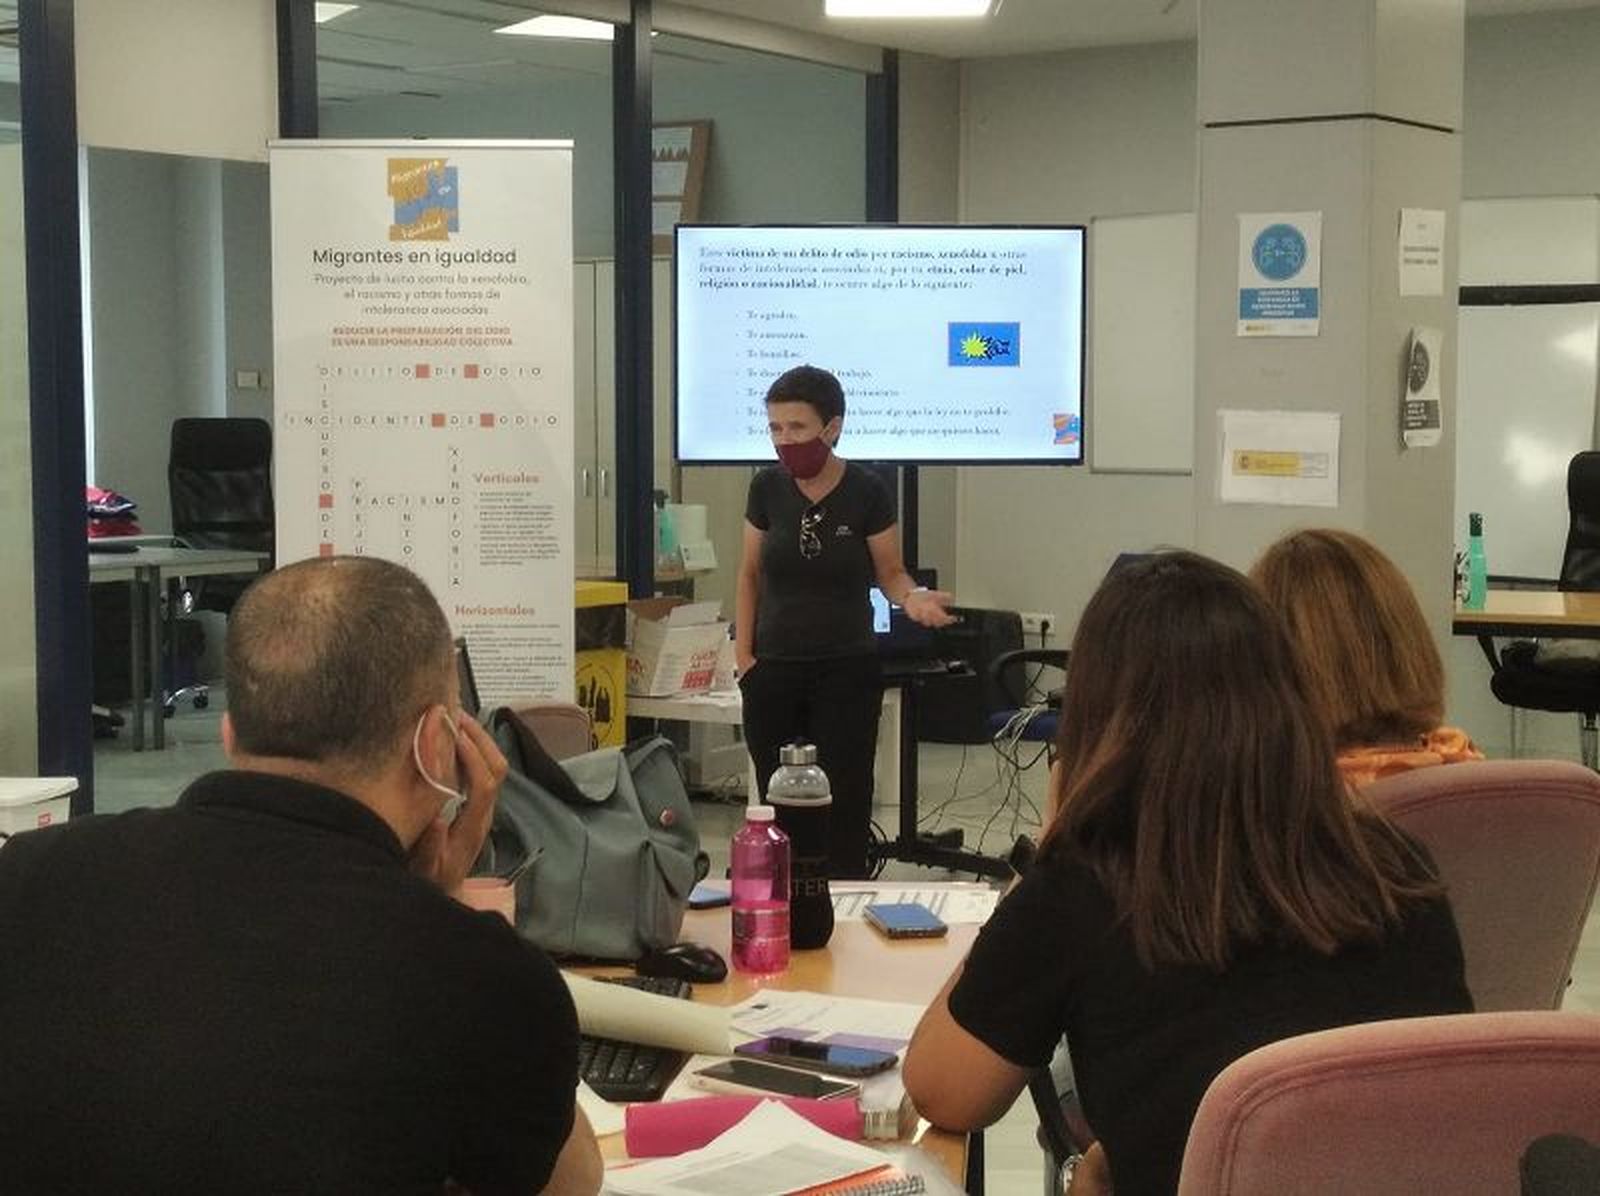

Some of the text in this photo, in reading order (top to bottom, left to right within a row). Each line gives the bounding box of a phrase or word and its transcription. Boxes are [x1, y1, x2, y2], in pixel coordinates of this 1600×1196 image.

[313, 248, 517, 268] Migrantes en igualdad
[767, 247, 780, 258] de
[783, 250, 797, 258] un
[800, 247, 828, 258] delito
[831, 247, 842, 258] de
[845, 247, 868, 258] odio
[871, 251, 887, 261] por
[740, 263, 751, 273] de
[891, 266, 907, 277] por
[959, 264, 985, 273] color
[989, 265, 1000, 273] de
[314, 272, 363, 286] Proyecto
[366, 272, 381, 284] de
[417, 272, 453, 284] contra
[455, 272, 469, 284] la
[344, 288, 355, 299] el
[403, 290, 410, 301] y
[413, 289, 442, 299] otras
[444, 288, 483, 299] formas
[485, 288, 501, 299] de
[430, 303, 489, 315] asociadas
[376, 326, 389, 335] LA
[485, 326, 511, 335] ODIO
[321, 366, 541, 377] DELITO DE ODIO
[289, 415, 558, 425] INCIDENTE DE ODIO
[473, 472, 540, 485] Verticales
[355, 496, 461, 506] RACISMO
[455, 603, 535, 616] Horizontales
